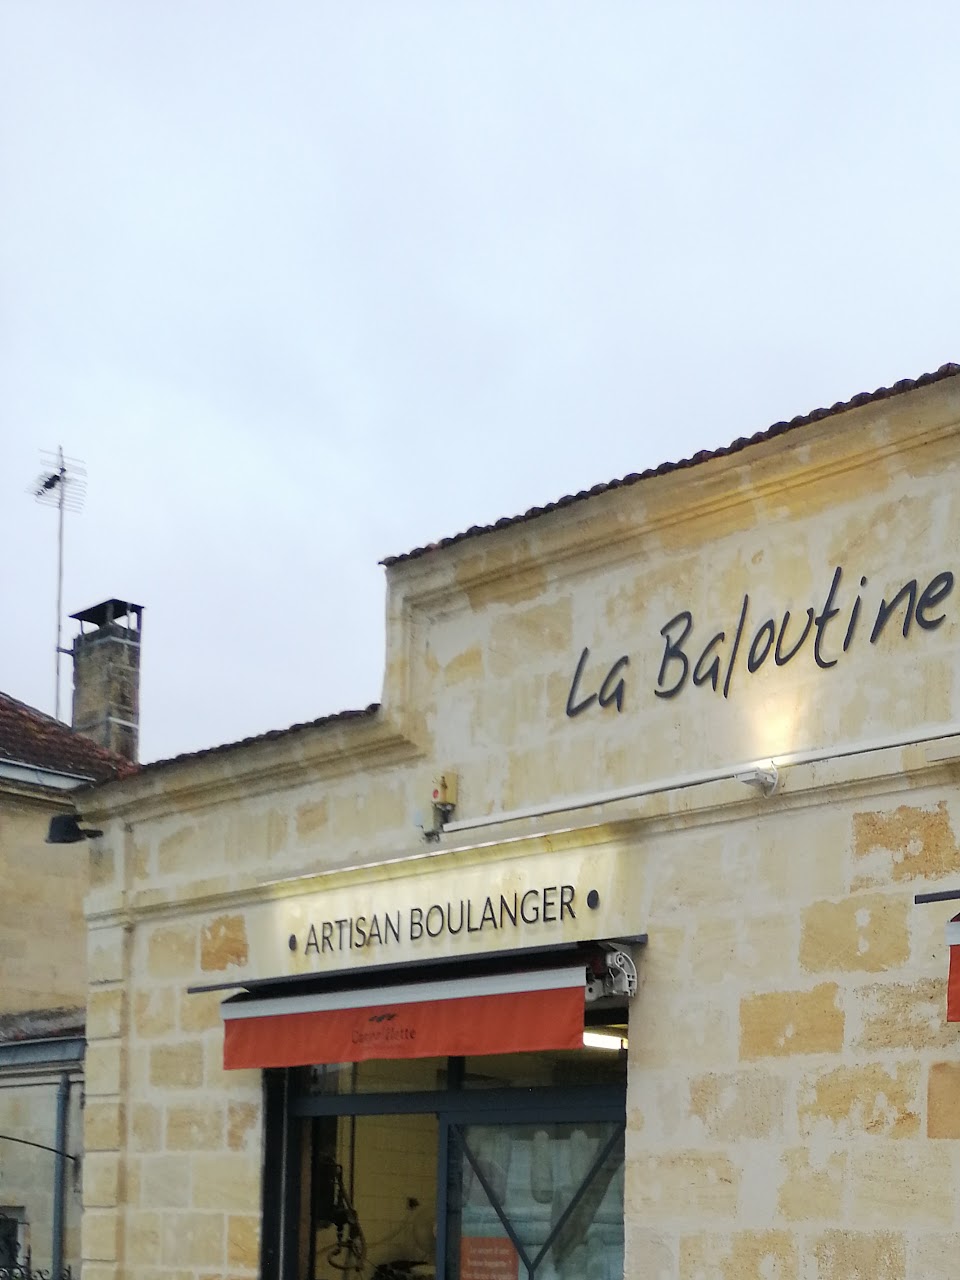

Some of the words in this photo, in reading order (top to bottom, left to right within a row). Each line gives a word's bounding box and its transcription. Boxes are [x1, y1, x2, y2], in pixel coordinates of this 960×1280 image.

[565, 647, 629, 718] La
[654, 566, 954, 699] Baloutine
[304, 913, 401, 955] ARTISAN
[410, 885, 576, 941] BOULANGER
